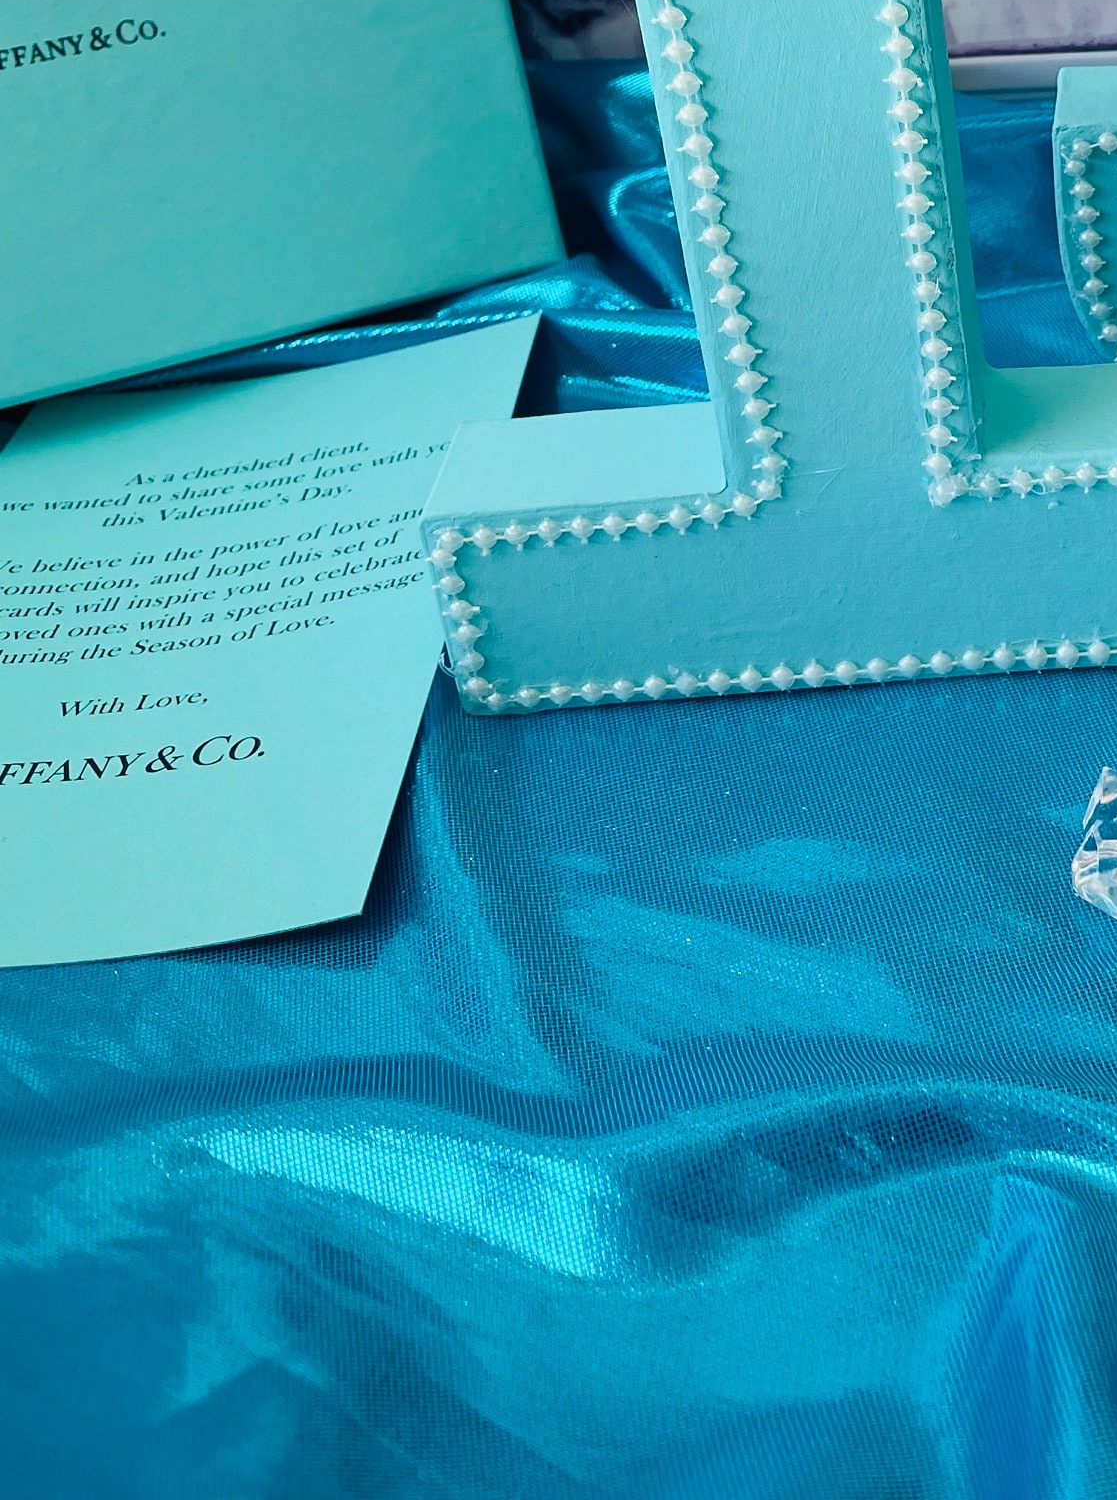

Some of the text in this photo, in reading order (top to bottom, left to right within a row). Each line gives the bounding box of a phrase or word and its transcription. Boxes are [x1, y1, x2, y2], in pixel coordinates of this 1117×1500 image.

[0, 33, 84, 70] FFANY
[2, 440, 451, 512] we wanted to share some love with yo
[124, 472, 155, 486] As
[162, 473, 174, 484] a
[182, 453, 294, 481] cherished
[102, 511, 145, 527] this
[300, 484, 352, 502] Day.
[0, 559, 23, 574] e
[32, 557, 122, 573] believe
[130, 551, 154, 566] in
[164, 547, 203, 562] the
[211, 534, 290, 560] power
[297, 523, 327, 542] of
[330, 517, 380, 536] love
[151, 566, 200, 585] and
[207, 558, 271, 578] hope
[279, 547, 322, 566] this
[331, 540, 365, 558] set
[374, 528, 404, 548] of
[75, 596, 120, 614] will
[127, 588, 216, 609] inspire
[222, 580, 271, 602] you
[281, 575, 304, 589] to
[314, 549, 425, 583] celebrate
[0, 570, 424, 641] oved ones with a special message
[80, 643, 121, 660] the
[130, 633, 221, 656] Season
[231, 622, 263, 642] of
[265, 614, 335, 636] Love.
[60, 691, 209, 717] With Love,
[0, 751, 146, 786] FFANY
